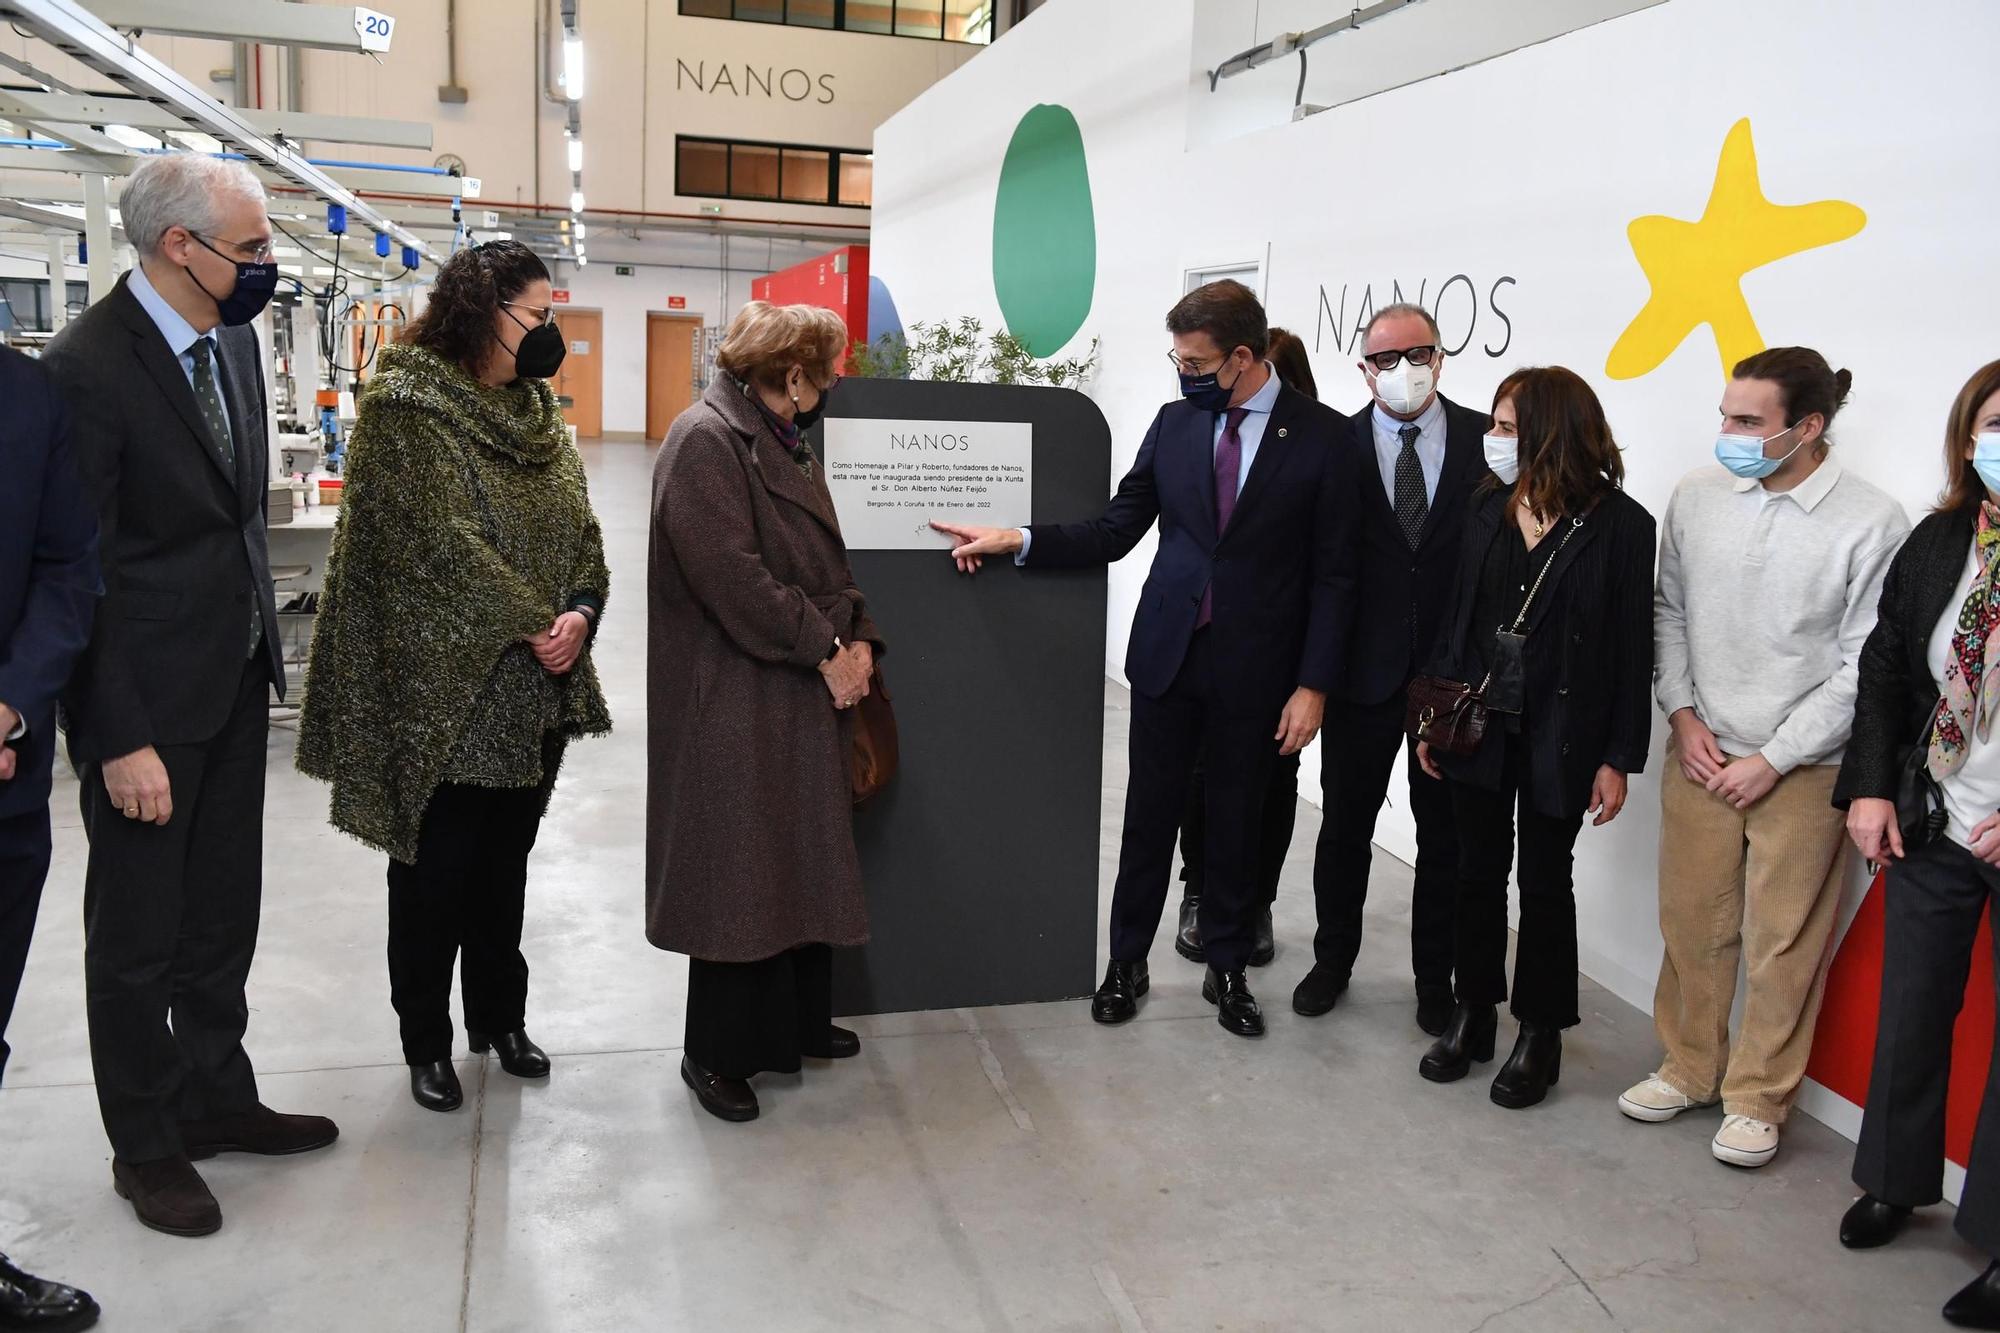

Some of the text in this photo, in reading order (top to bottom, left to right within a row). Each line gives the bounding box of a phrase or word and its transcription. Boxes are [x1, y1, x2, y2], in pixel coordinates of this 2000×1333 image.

[366, 16, 389, 36] 20
[676, 58, 836, 105] NANOS
[891, 434, 969, 450] NANOS
[854, 462, 888, 471] Homenaje
[897, 462, 913, 470] Pilar
[922, 463, 951, 472] Roberto,
[953, 463, 988, 471] fundadores
[991, 464, 999, 472] de
[1001, 464, 1024, 473] Nanos,
[869, 473, 880, 481] fue
[883, 474, 921, 482] inaugurada
[948, 474, 982, 483] presidente
[940, 485, 963, 493] Núñez
[966, 485, 987, 494] Feijóo
